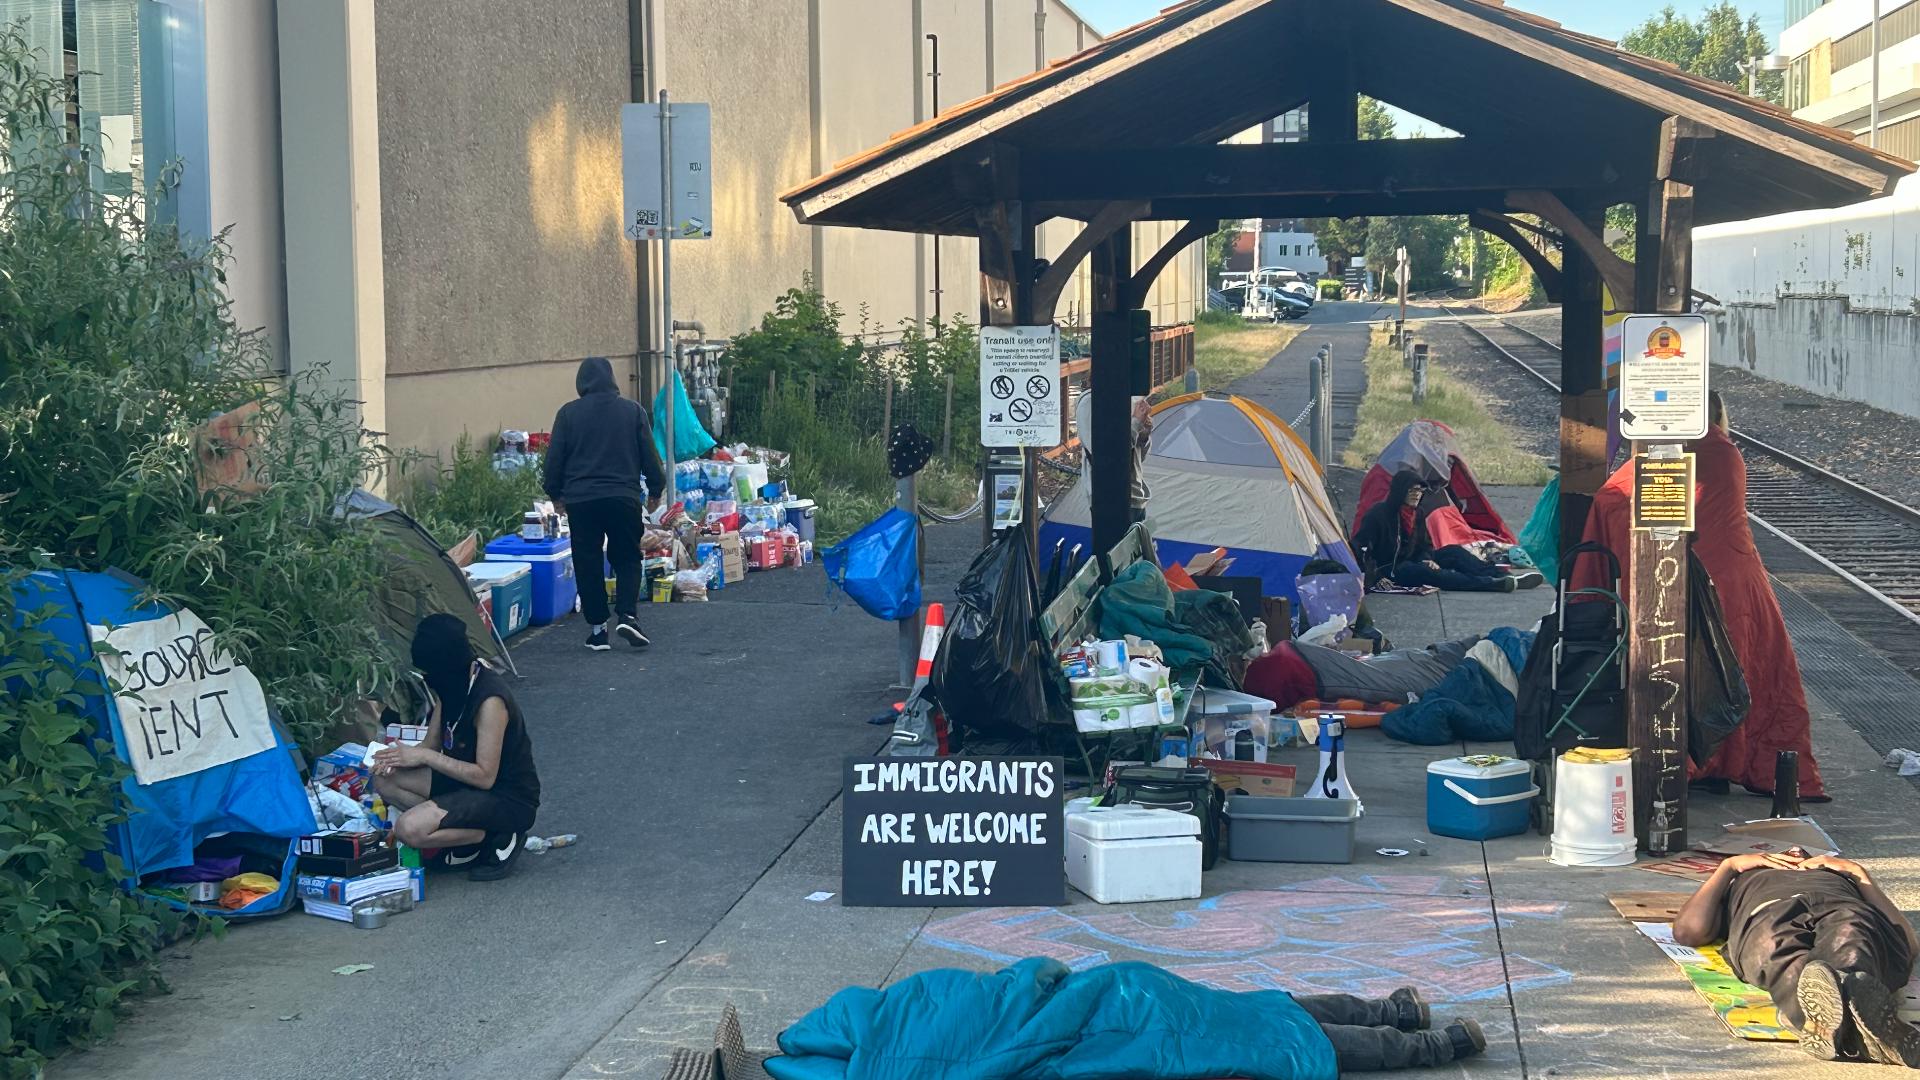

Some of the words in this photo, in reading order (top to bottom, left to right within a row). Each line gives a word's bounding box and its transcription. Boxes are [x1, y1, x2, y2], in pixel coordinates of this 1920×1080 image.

[984, 336, 1015, 345] Transit
[853, 760, 1055, 798] IMMIGRANTS
[860, 812, 916, 844] ARE
[924, 811, 1047, 845] WELCOME
[901, 859, 997, 896] HERE!
